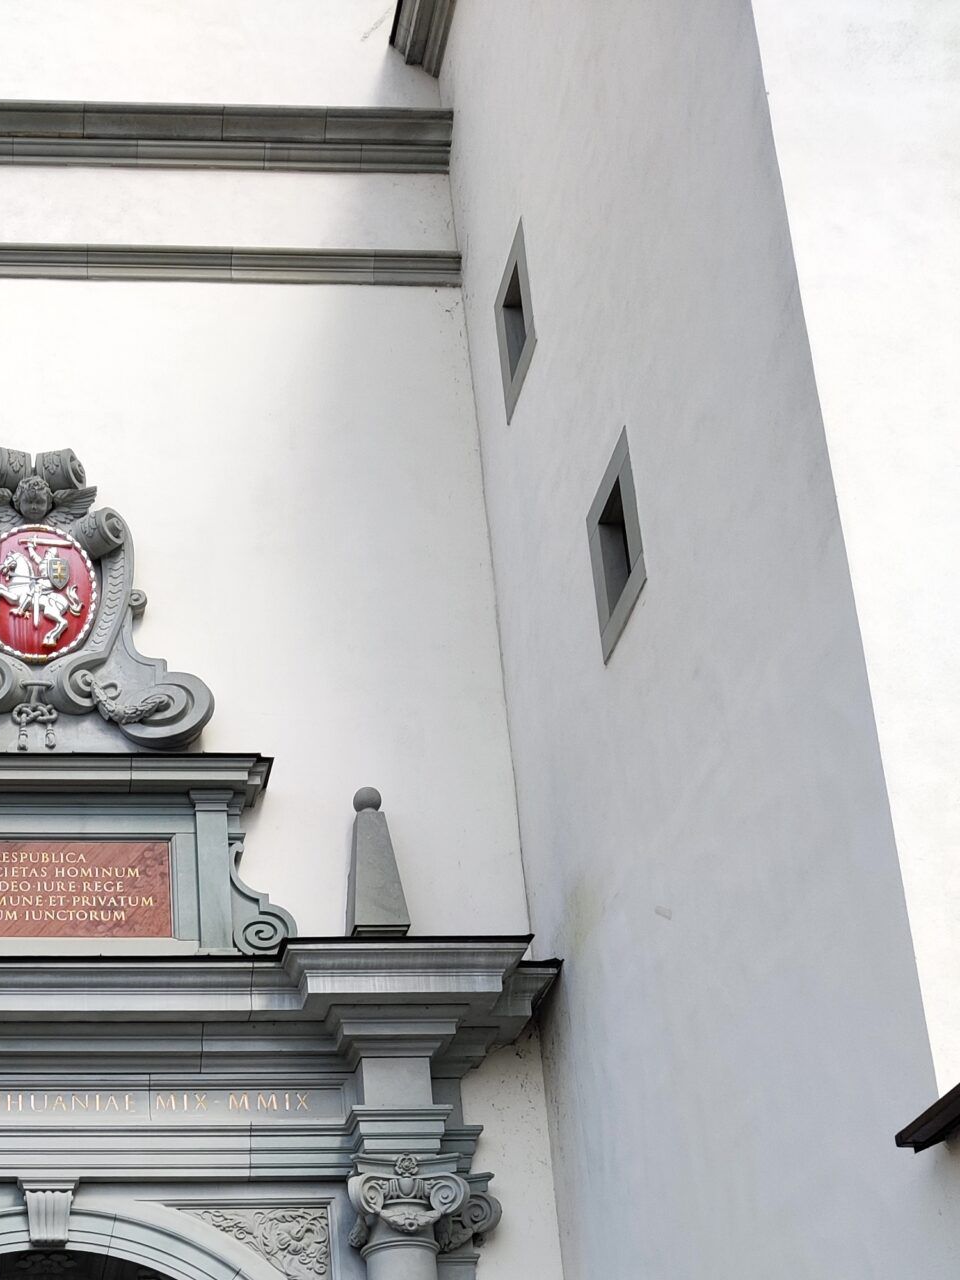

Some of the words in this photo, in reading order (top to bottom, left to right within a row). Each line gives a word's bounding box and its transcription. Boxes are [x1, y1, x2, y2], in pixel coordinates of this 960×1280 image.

[55, 866, 141, 878] HOMINUM
[72, 896, 154, 907] PRIVATUM
[25, 910, 126, 921] IUNCTORUM
[155, 1093, 208, 1112] MIX
[228, 1093, 312, 1112] MMIX
